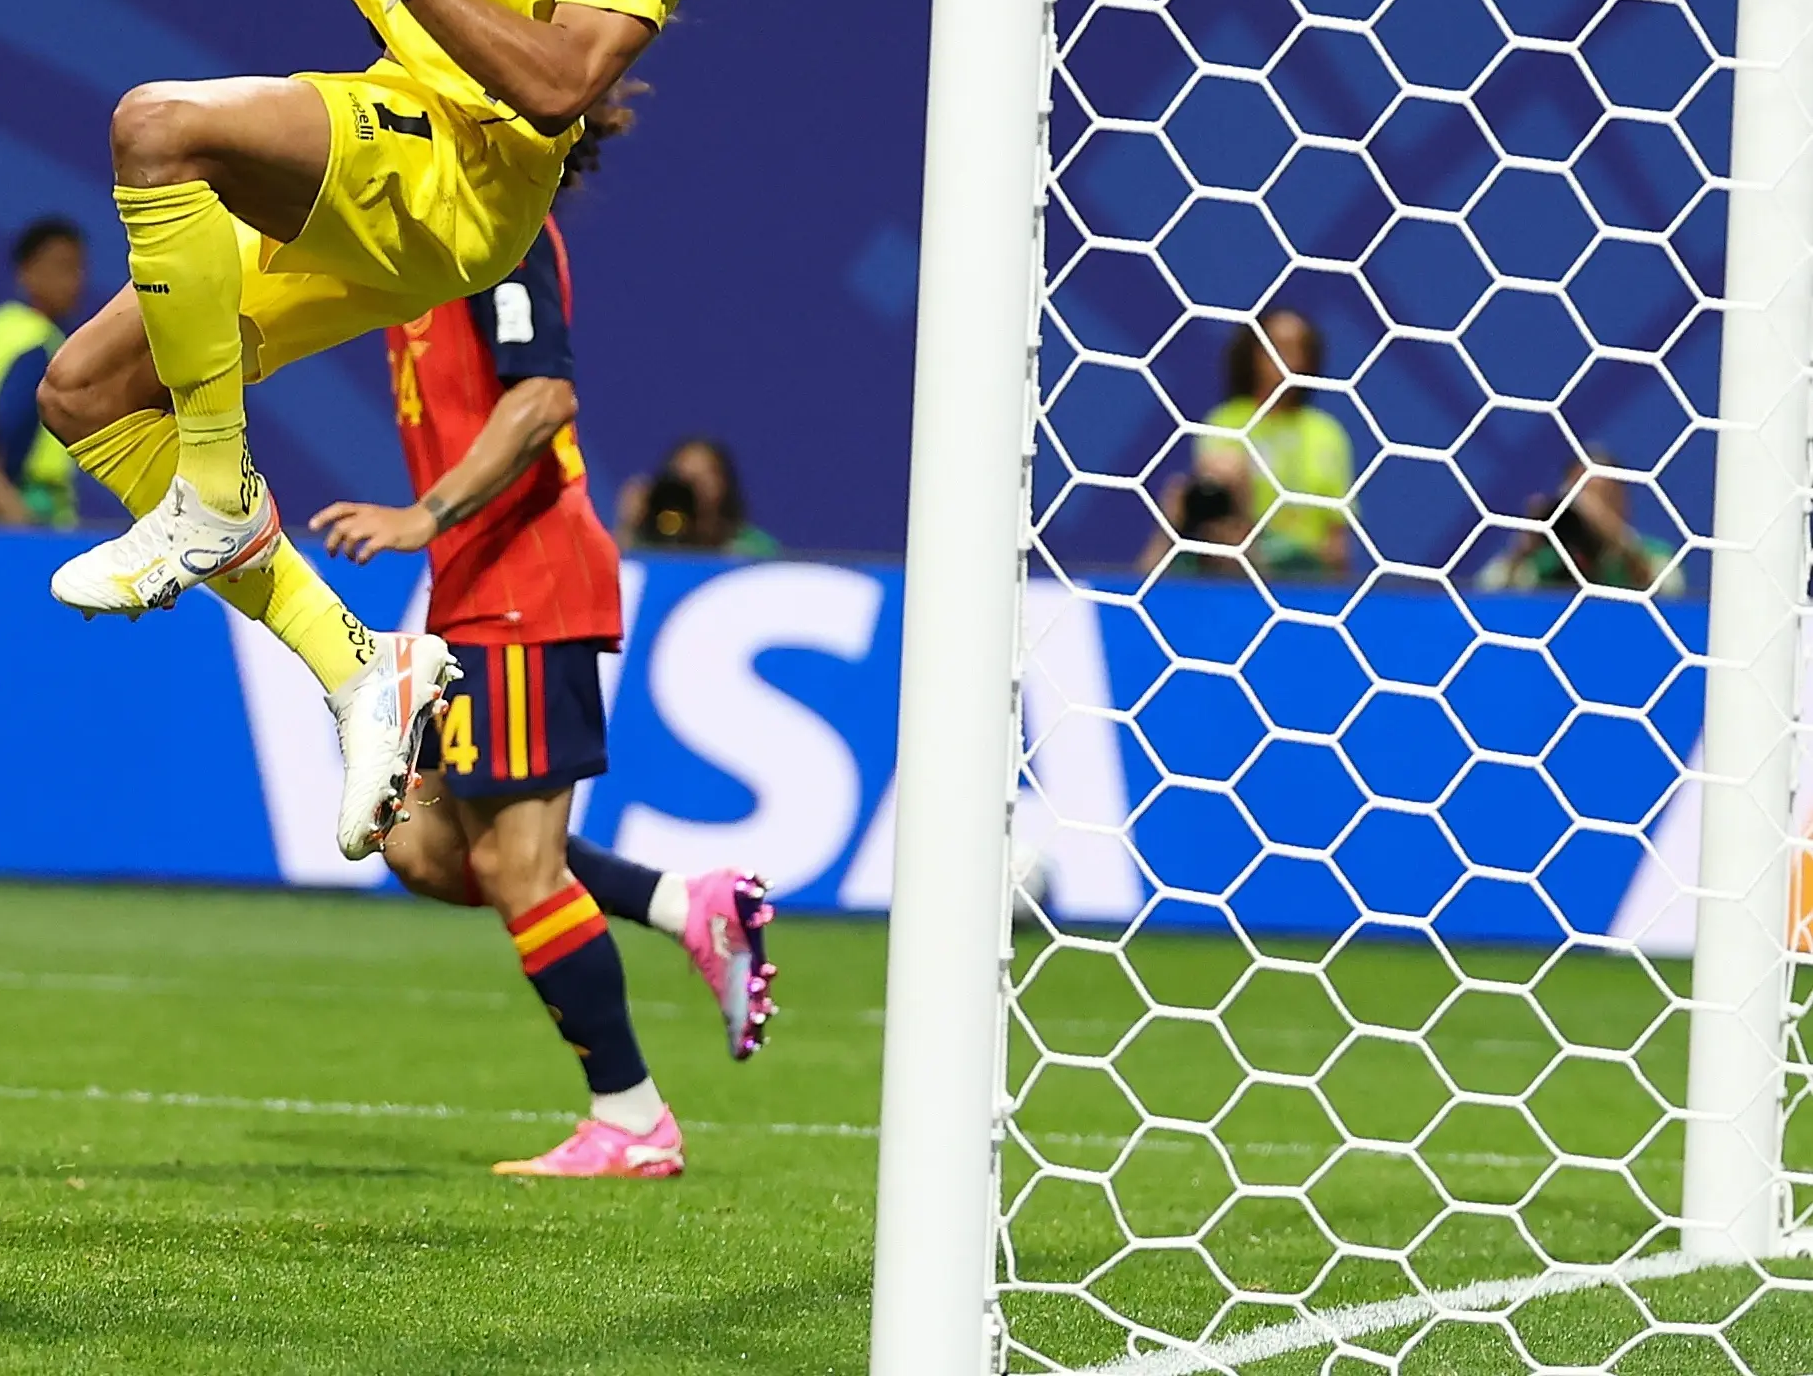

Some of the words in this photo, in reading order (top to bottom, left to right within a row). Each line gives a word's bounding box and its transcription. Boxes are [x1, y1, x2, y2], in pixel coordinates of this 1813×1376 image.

[348, 91, 374, 141] capelli
[371, 102, 433, 141] 1
[137, 563, 168, 594] FCF
